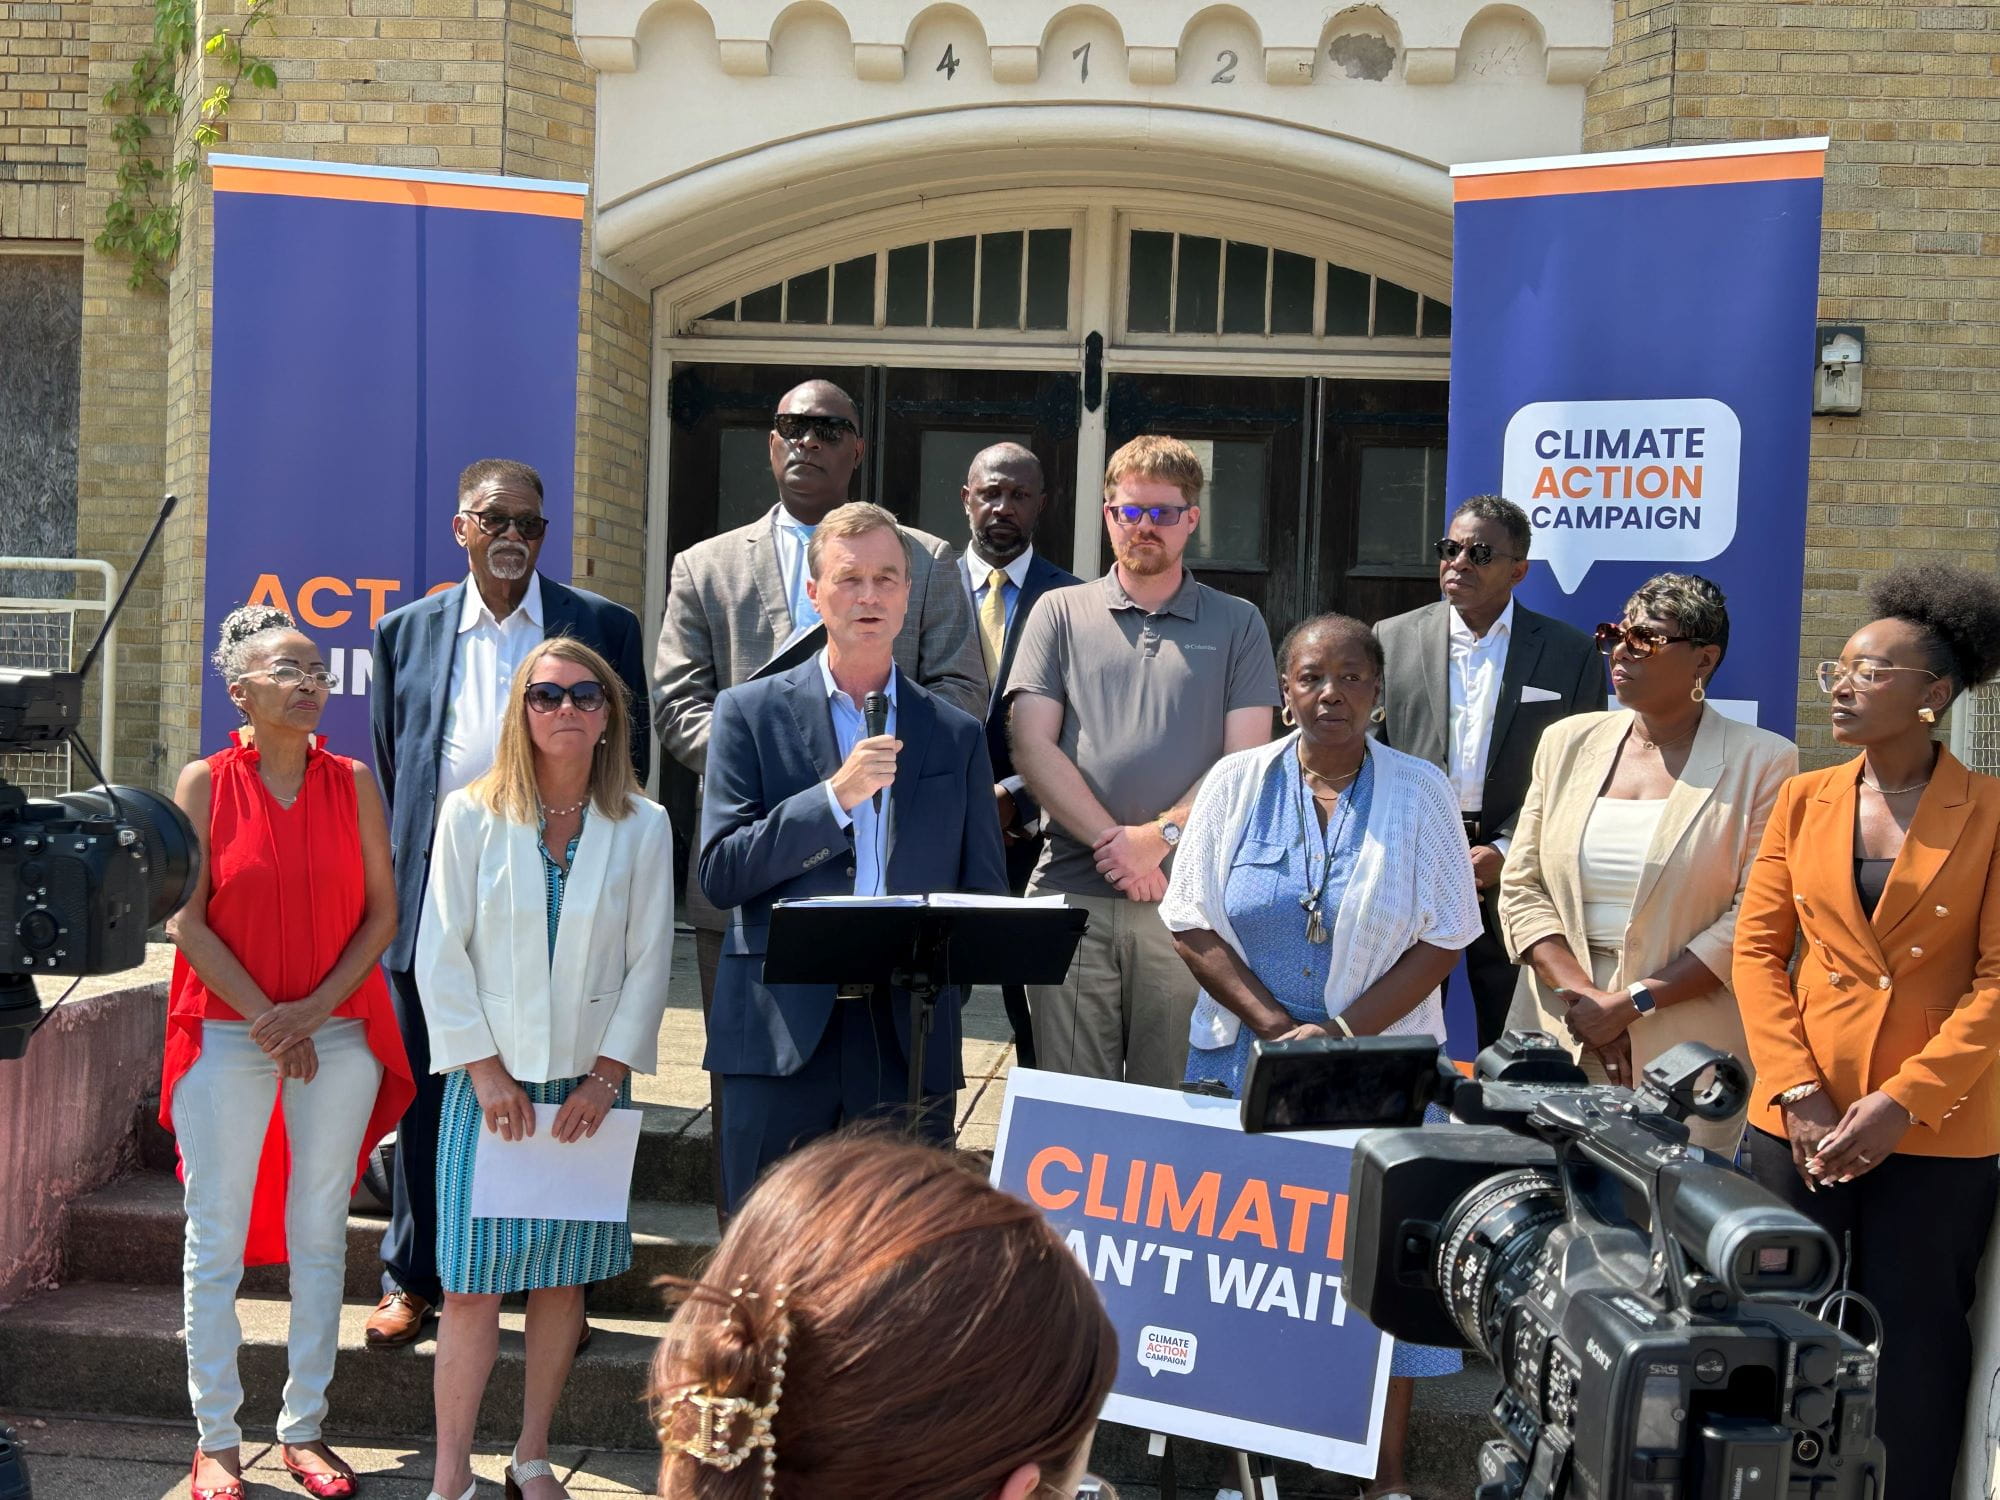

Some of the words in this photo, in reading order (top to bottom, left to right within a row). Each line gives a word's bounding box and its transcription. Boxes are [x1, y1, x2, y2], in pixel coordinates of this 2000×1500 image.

[936, 43, 960, 81] 4
[1211, 50, 1239, 84] 2
[1534, 427, 1705, 460] CLIMATE
[1531, 465, 1703, 499] ACTION
[1531, 506, 1701, 530] CAMPAIGN
[247, 573, 401, 630] ACT
[1064, 1229, 1193, 1295] AN'T
[1207, 1253, 1346, 1327] WAIT
[1146, 1342, 1188, 1358] ACTION
[1148, 1332, 1190, 1349] CLIMATE
[1585, 1337, 1612, 1371] SONY
[1145, 1351, 1187, 1367] CAMPAIGN
